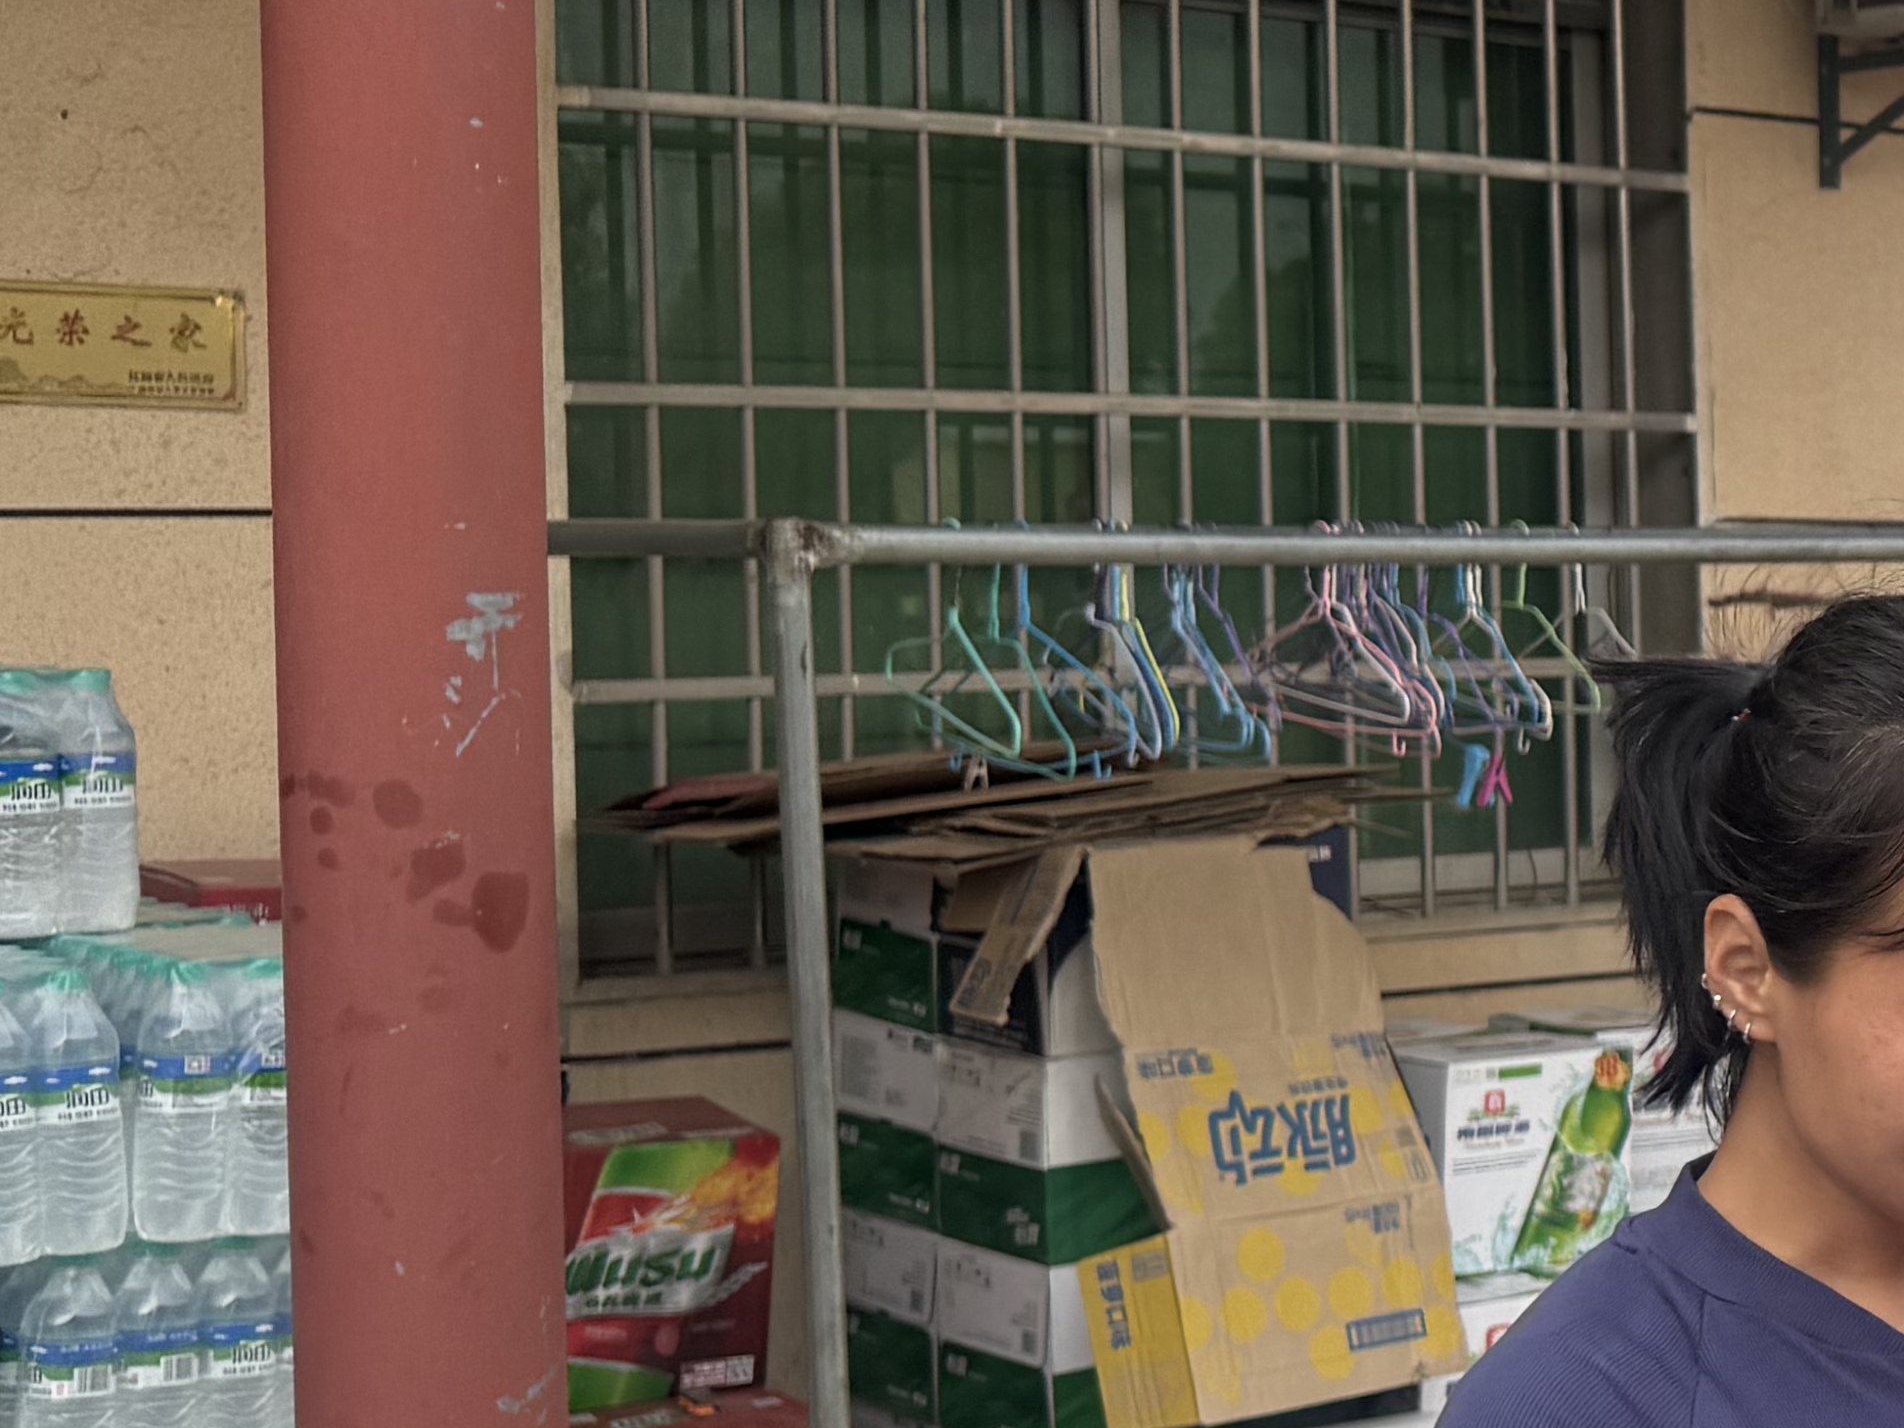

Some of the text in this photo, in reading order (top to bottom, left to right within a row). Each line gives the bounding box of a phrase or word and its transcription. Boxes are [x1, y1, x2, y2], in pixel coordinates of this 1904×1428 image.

[0, 306, 207, 354] 光荣之家
[1206, 1091, 1357, 1188] 脉动
